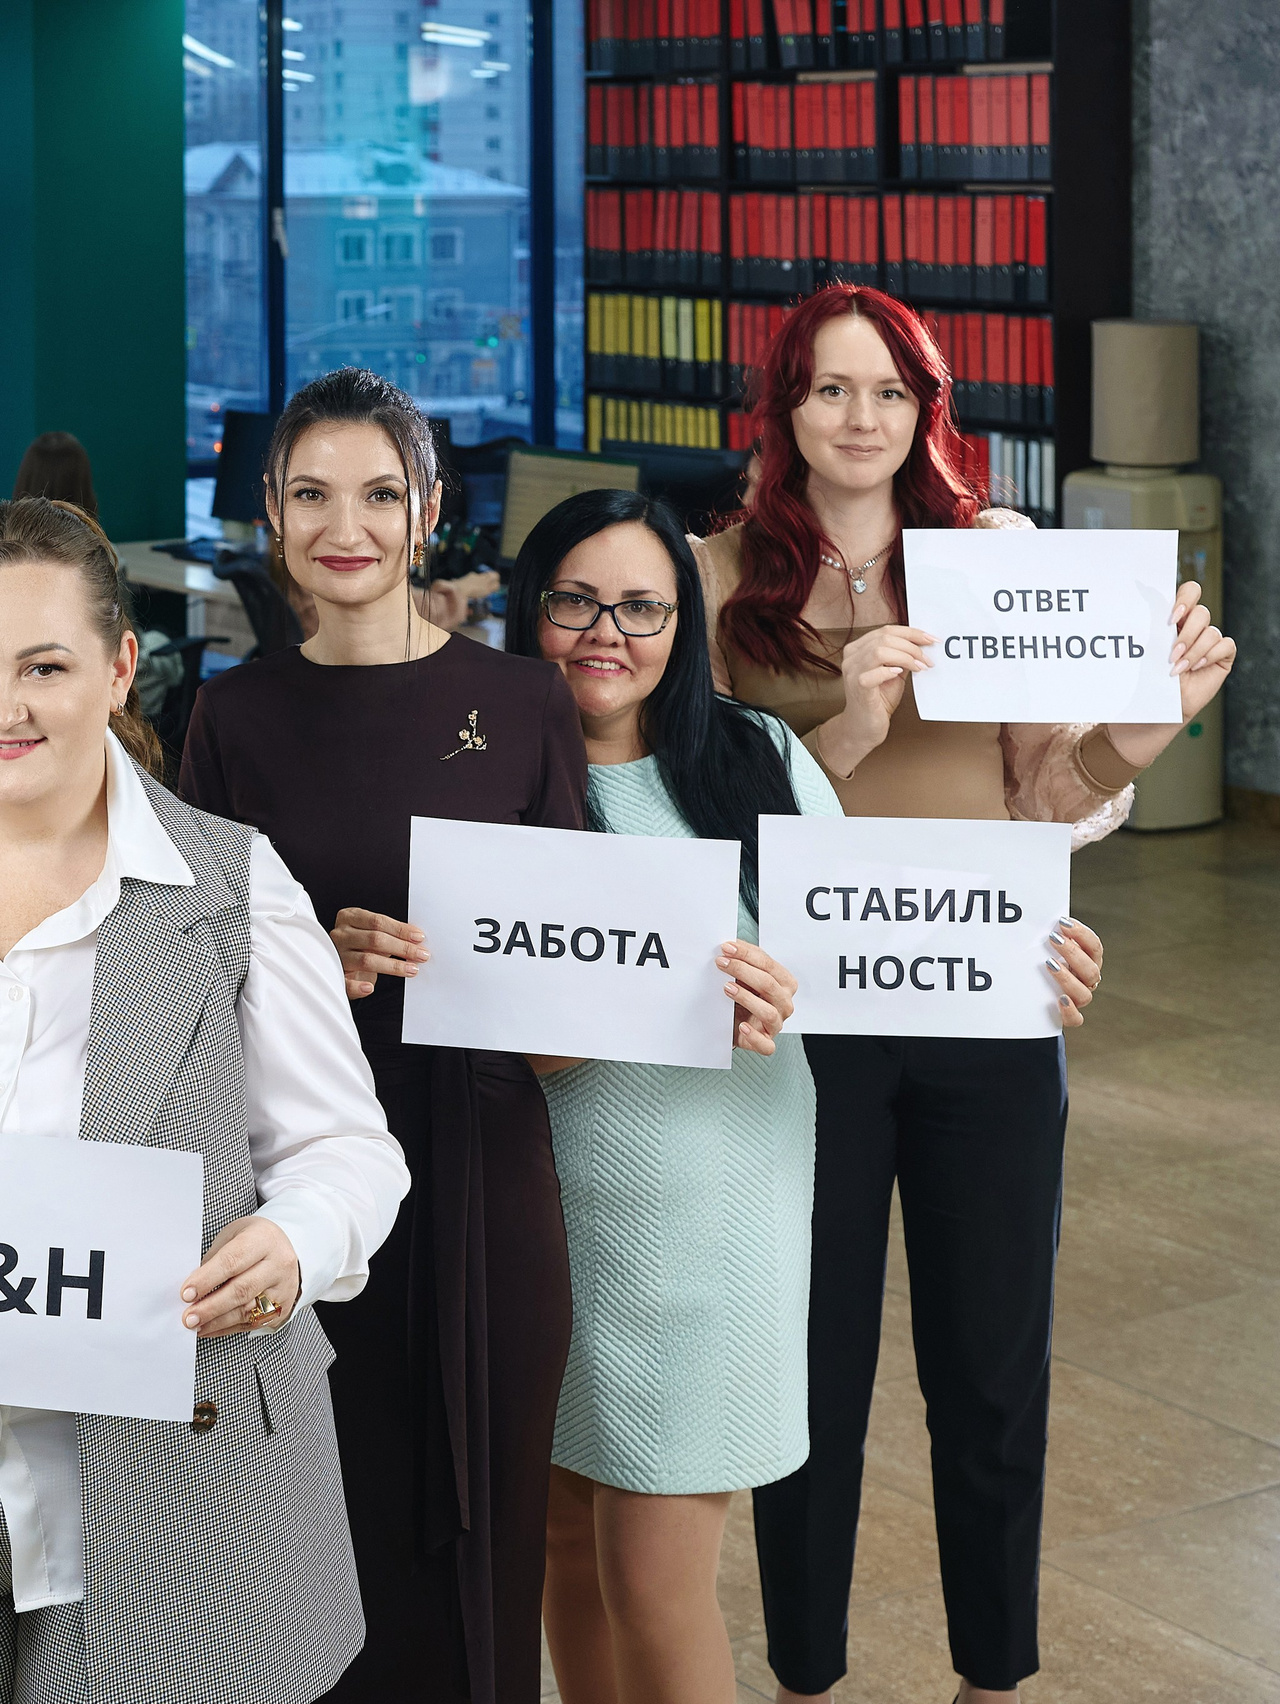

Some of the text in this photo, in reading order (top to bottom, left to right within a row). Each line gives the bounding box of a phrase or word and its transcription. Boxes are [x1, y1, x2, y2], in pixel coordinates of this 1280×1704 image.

[993, 589, 1090, 613] ОТВЕТ
[944, 635, 1145, 660] СТВЕННОСТЬ
[805, 886, 1023, 924] СТАБИЛЬ
[472, 917, 670, 969] ЗАБОТА
[838, 955, 993, 992] НОСТЬ
